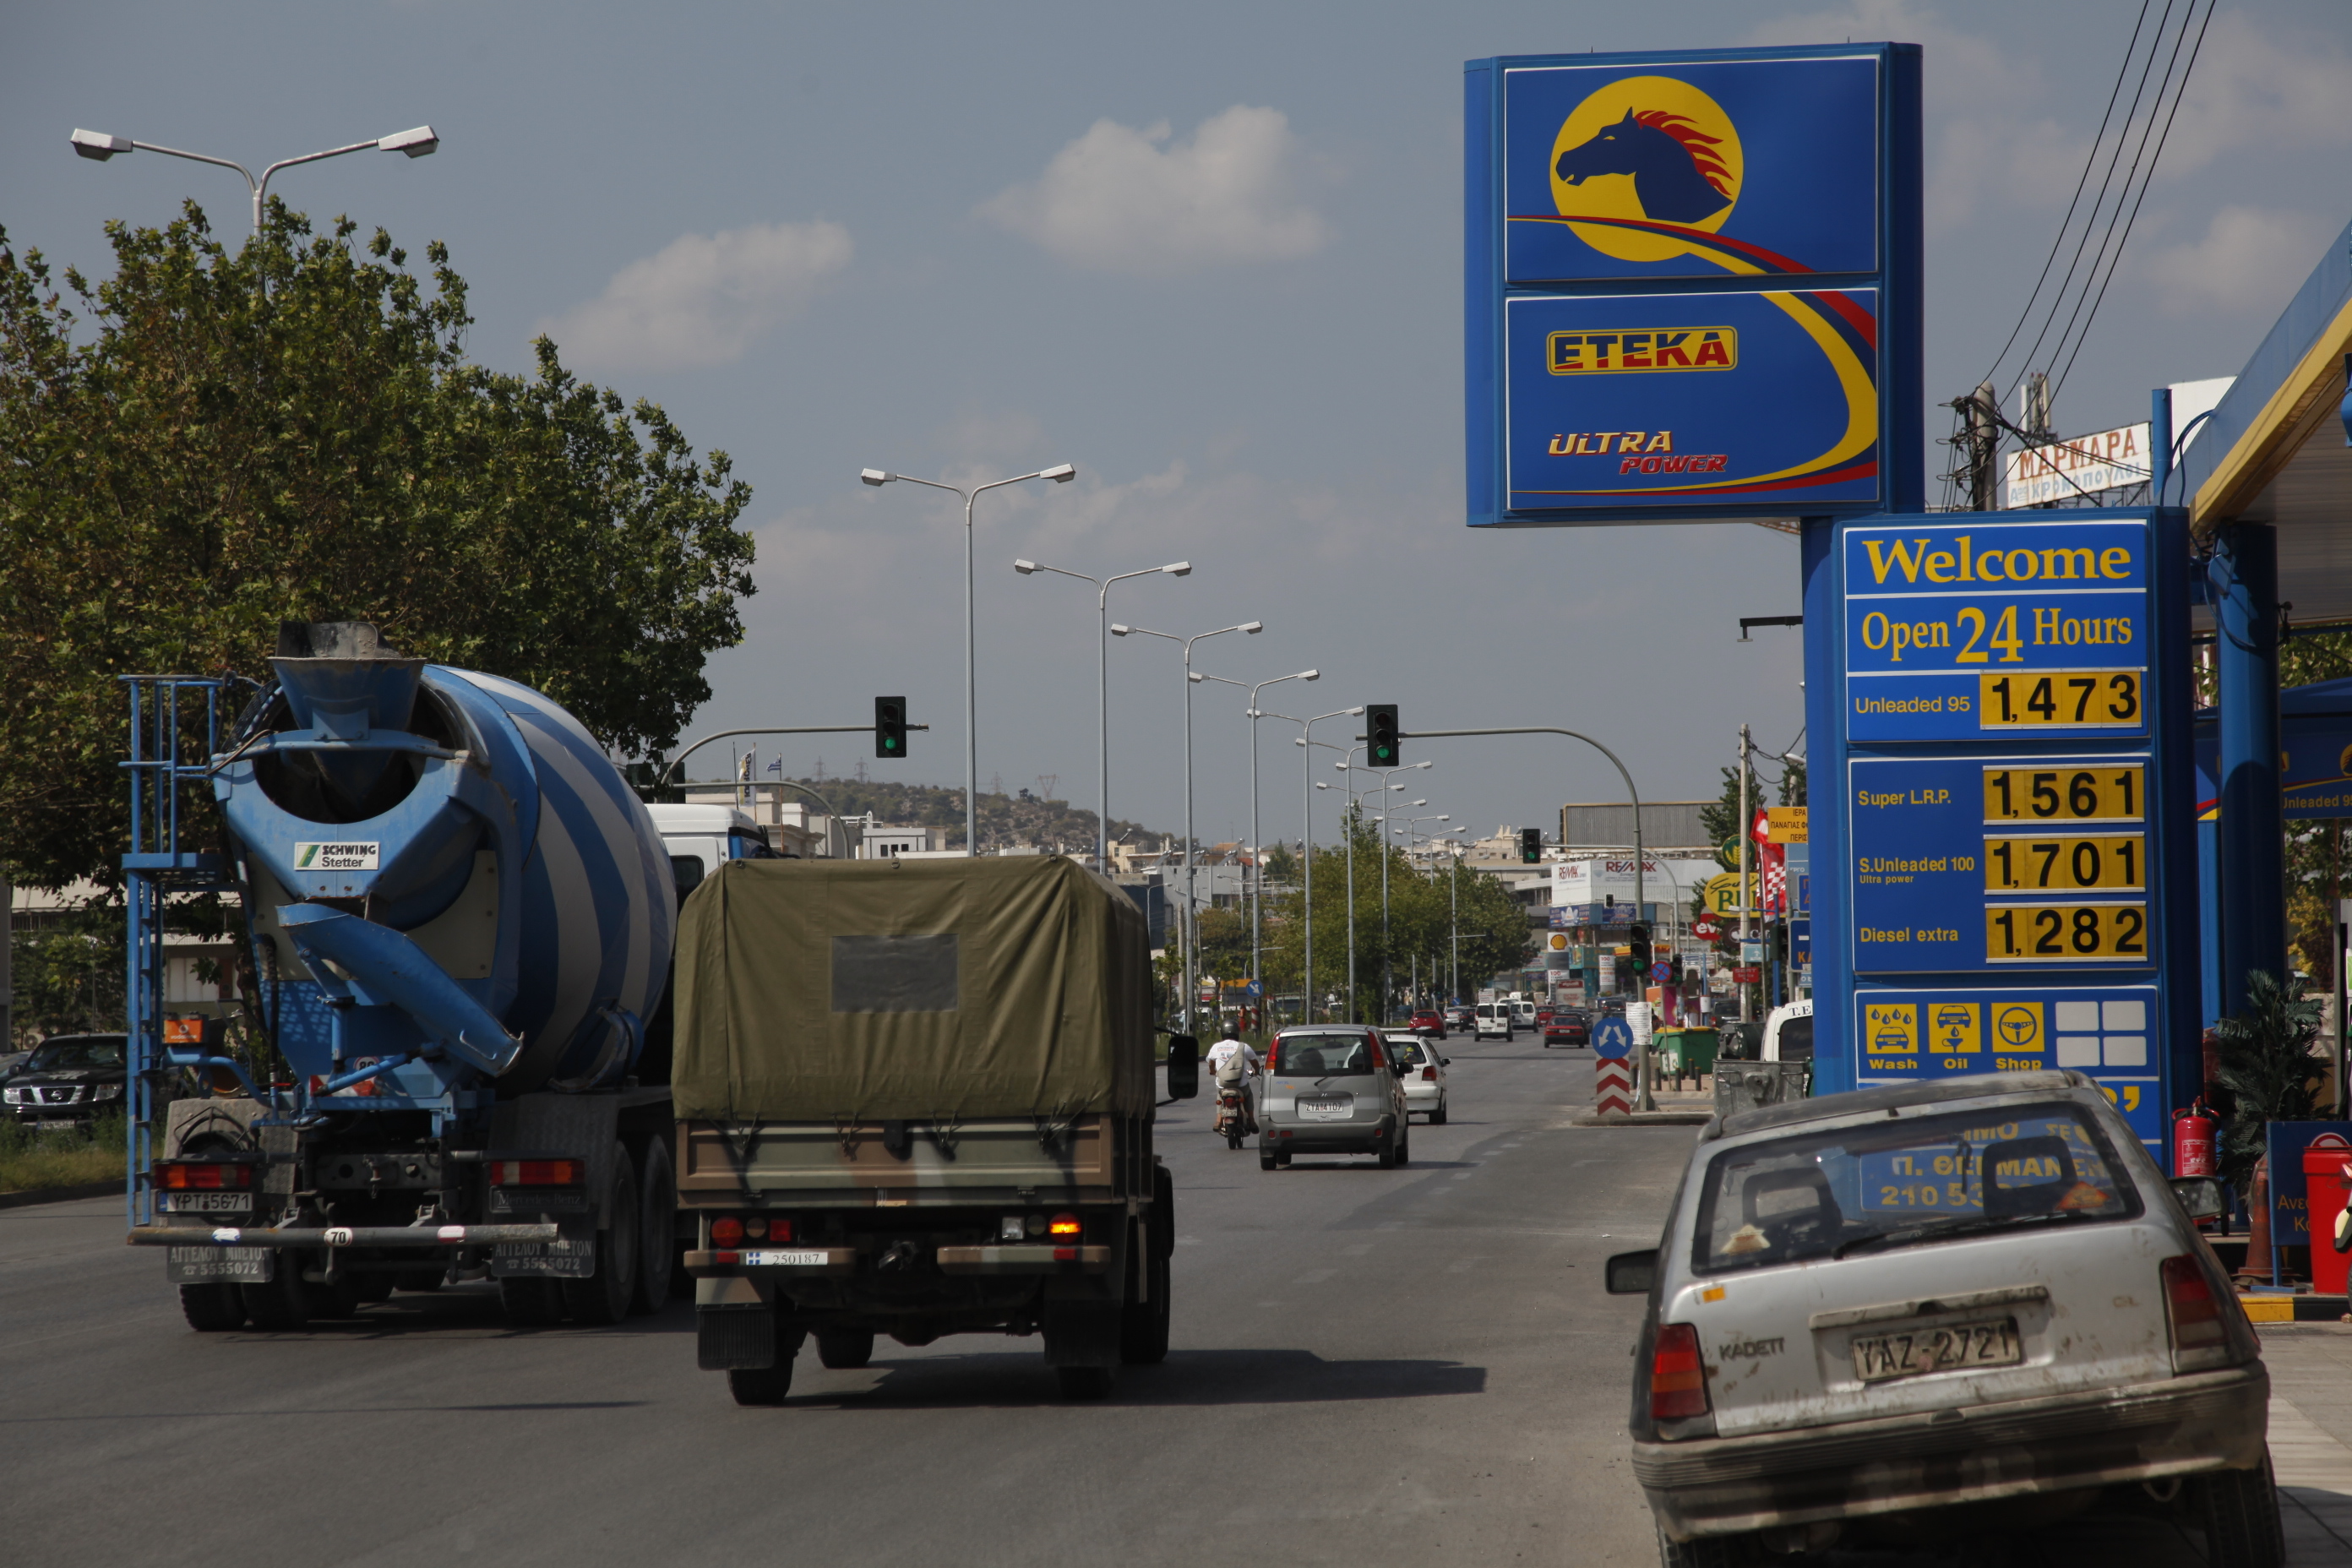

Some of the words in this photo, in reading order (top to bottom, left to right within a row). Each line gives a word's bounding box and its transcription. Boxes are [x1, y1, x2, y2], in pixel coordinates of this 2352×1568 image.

[1554, 331, 1730, 370] ETEKA
[1549, 430, 1673, 456] ULTRA
[1620, 454, 1729, 475] POWER
[2019, 428, 2138, 480] ΜΑΡΜΑΡΑ
[1861, 535, 2132, 585] Welcome
[1862, 612, 1951, 662] Open
[1956, 605, 2024, 663] 24
[2033, 607, 2132, 646] Hours
[1854, 696, 1942, 715] Unleaded
[1947, 696, 1971, 712] 95
[1991, 674, 2137, 723] 1,473
[1858, 790, 1906, 807] Super
[1909, 789, 1952, 805] L.R.P.
[1991, 770, 2135, 818] 1,561
[322, 845, 377, 856] SCHWING
[321, 856, 364, 868] Stetter
[1859, 858, 1946, 873] S.Unleaded
[1950, 856, 1975, 872] 100
[1992, 840, 2136, 888] 1,701
[1859, 875, 1883, 885] Ultra
[1885, 874, 1914, 886] power
[1859, 928, 1910, 943] Diesel
[1917, 928, 1959, 942] extra
[1995, 908, 2143, 956] 1,282
[1869, 1059, 1918, 1070] Wash
[1943, 1058, 1968, 1069] Oil
[1995, 1058, 2043, 1071] Shop
[498, 1193, 581, 1206] Mercedes-Benz
[1881, 1185, 1939, 1206] 210
[330, 1231, 346, 1246] 70
[199, 1262, 259, 1276] 5555072
[522, 1256, 580, 1271] 5555072
[1718, 1337, 1786, 1362] KADETT
